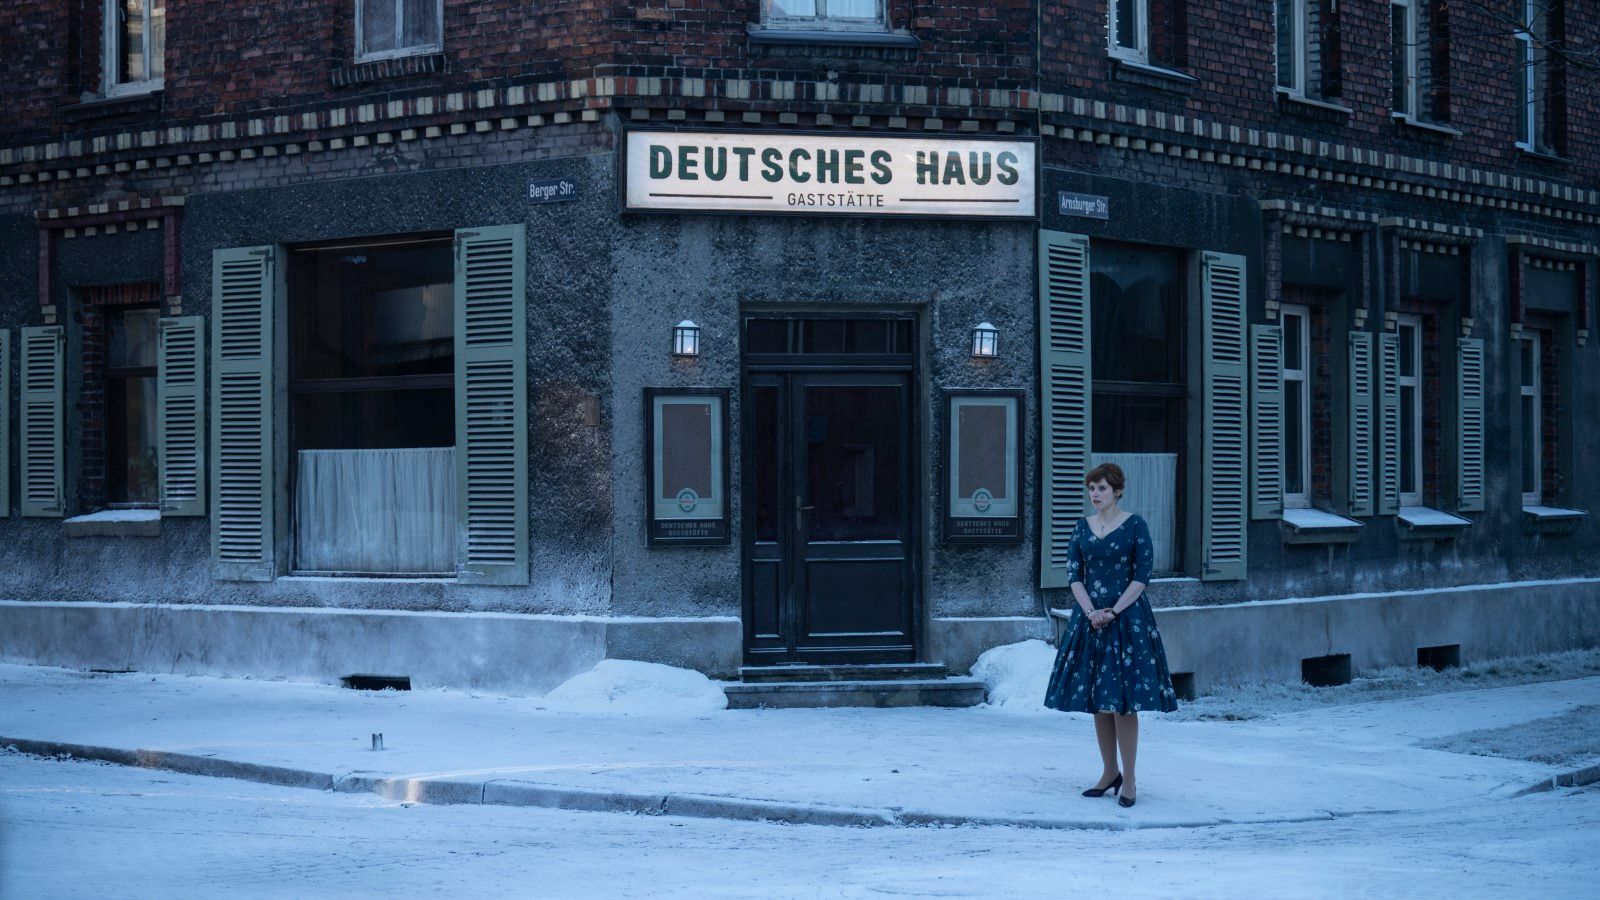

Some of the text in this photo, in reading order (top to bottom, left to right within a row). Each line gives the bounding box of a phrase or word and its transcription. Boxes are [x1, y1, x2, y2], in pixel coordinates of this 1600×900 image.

[649, 144, 1019, 186] DEUTSCHES HAUS
[529, 180, 576, 200] Berger Str.
[787, 190, 885, 207] GASTSTÄTTE
[1061, 194, 1095, 215] Arnsburger
